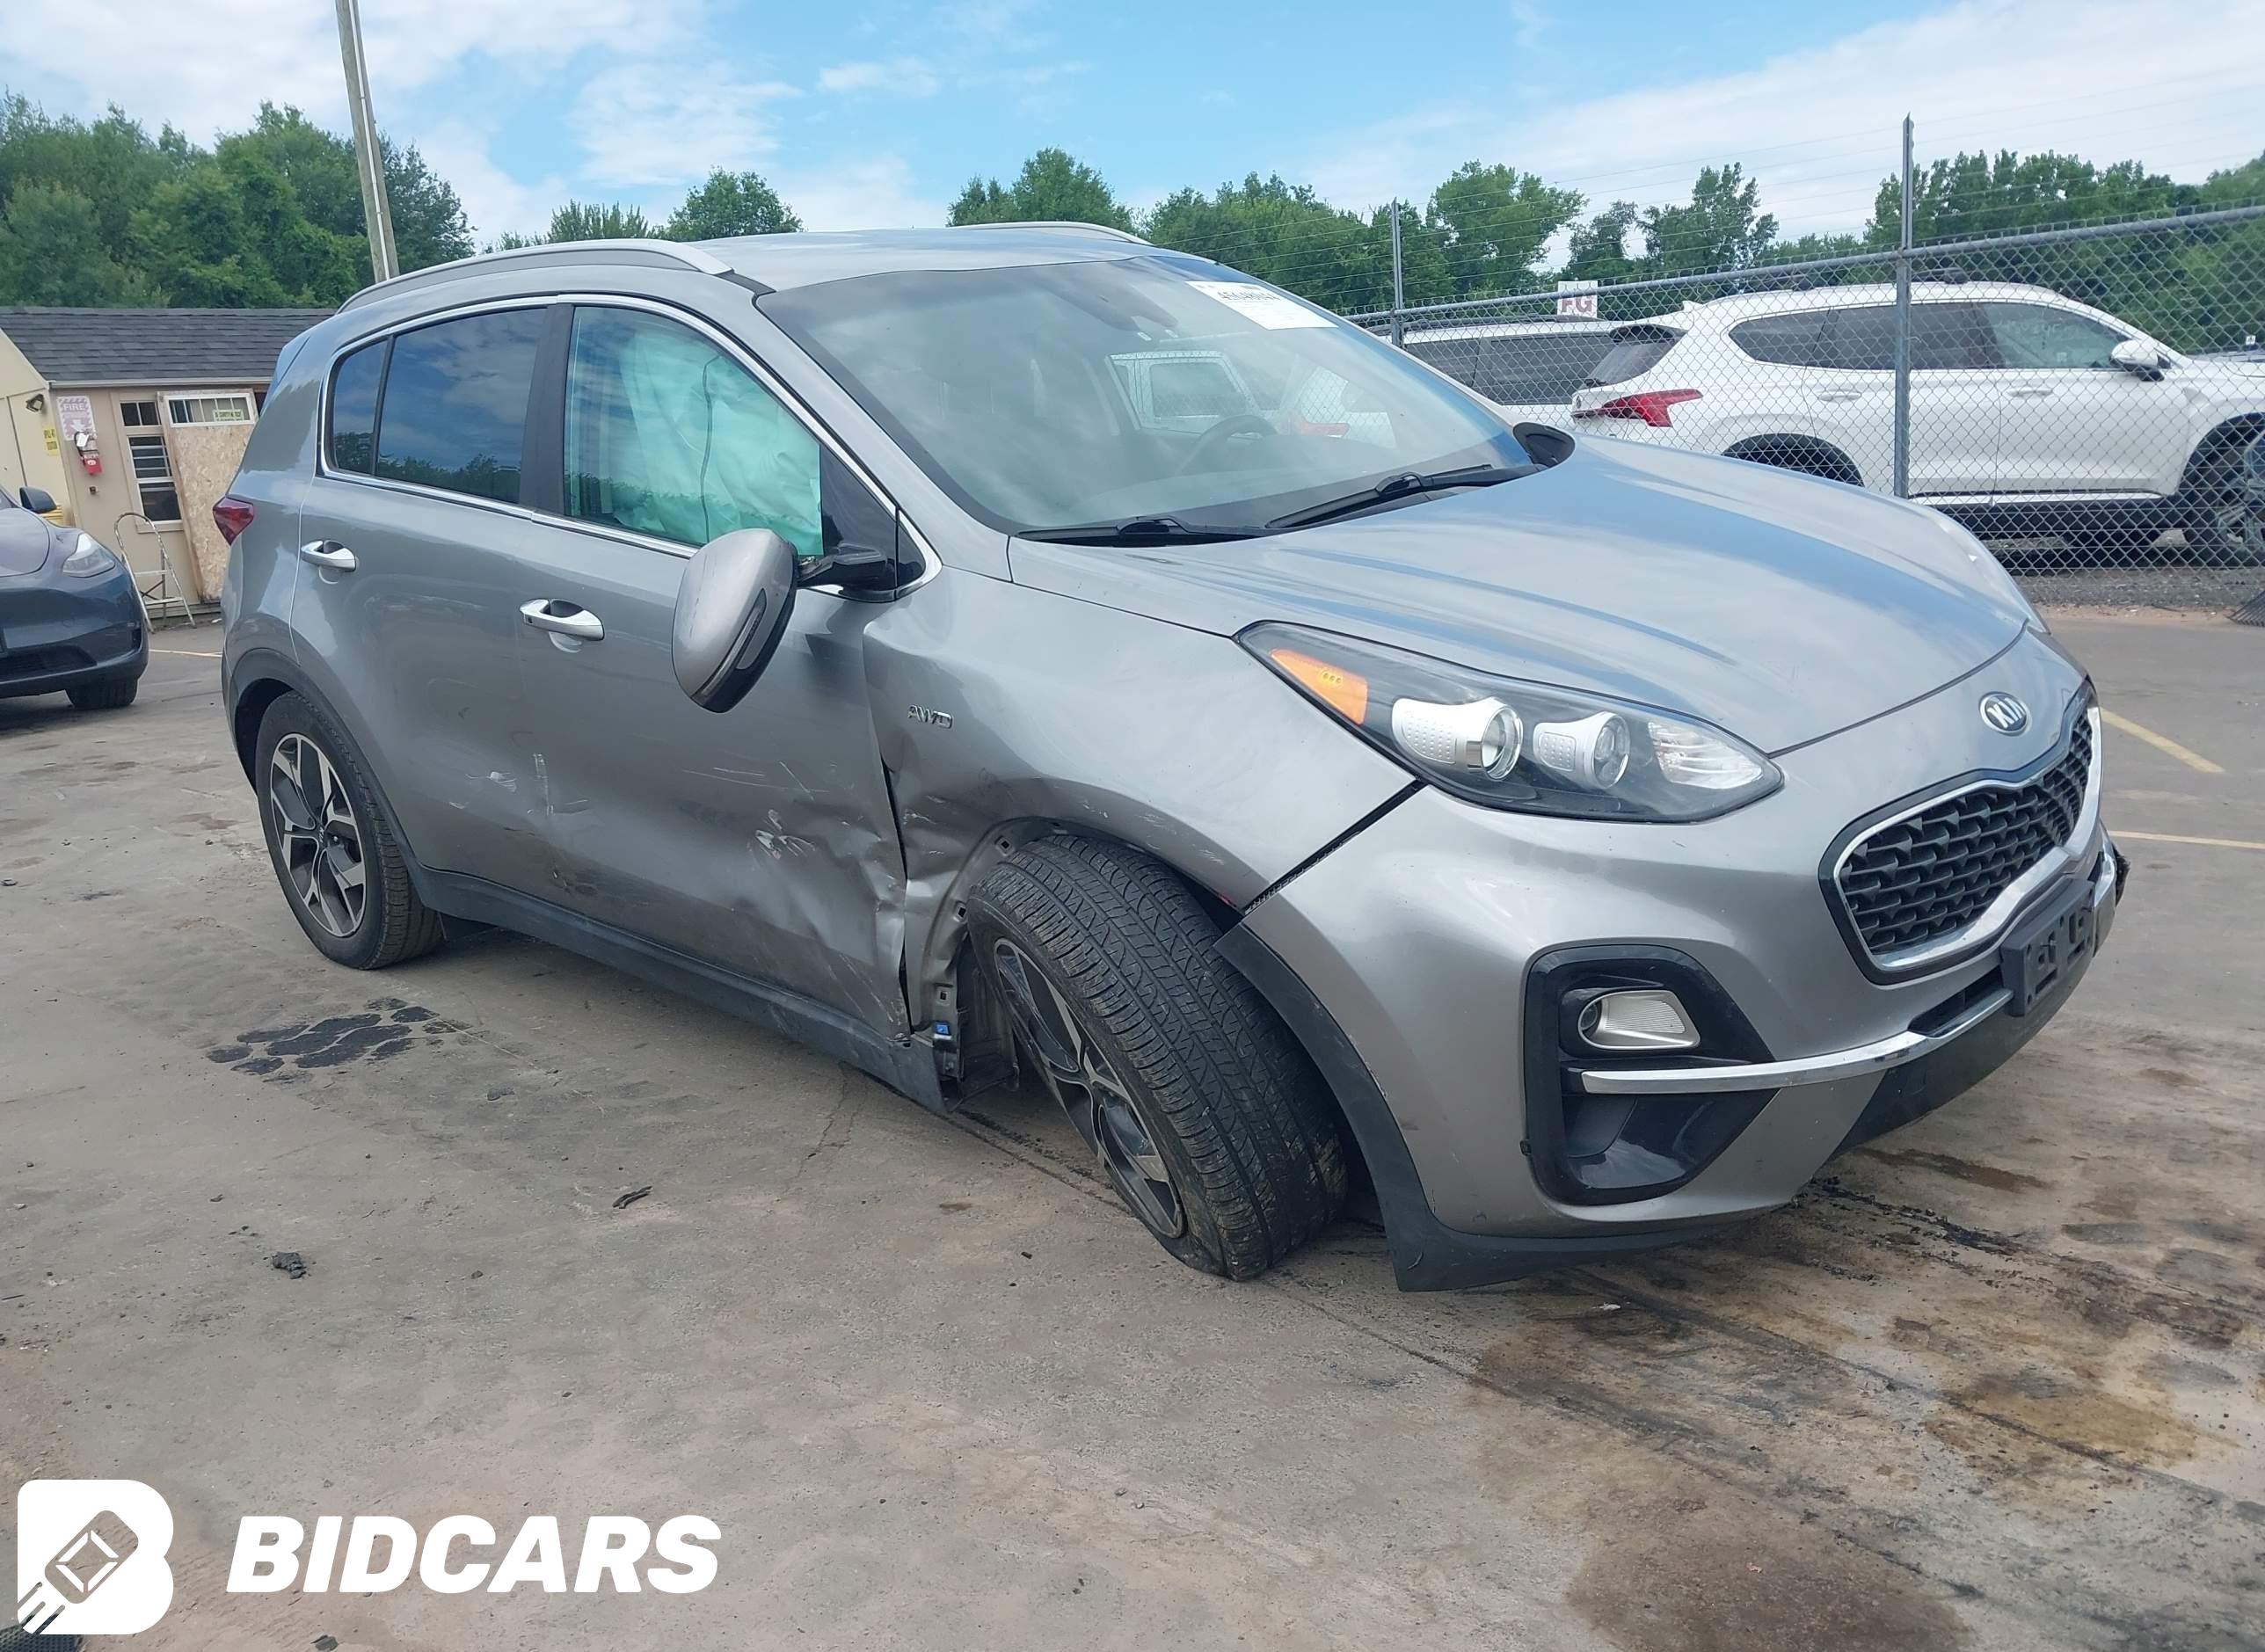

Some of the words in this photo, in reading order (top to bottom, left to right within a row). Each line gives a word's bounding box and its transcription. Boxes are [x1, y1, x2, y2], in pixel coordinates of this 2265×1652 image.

[1561, 295, 1593, 313] FG
[63, 403, 85, 411] FIRE
[907, 703, 954, 730] AWD
